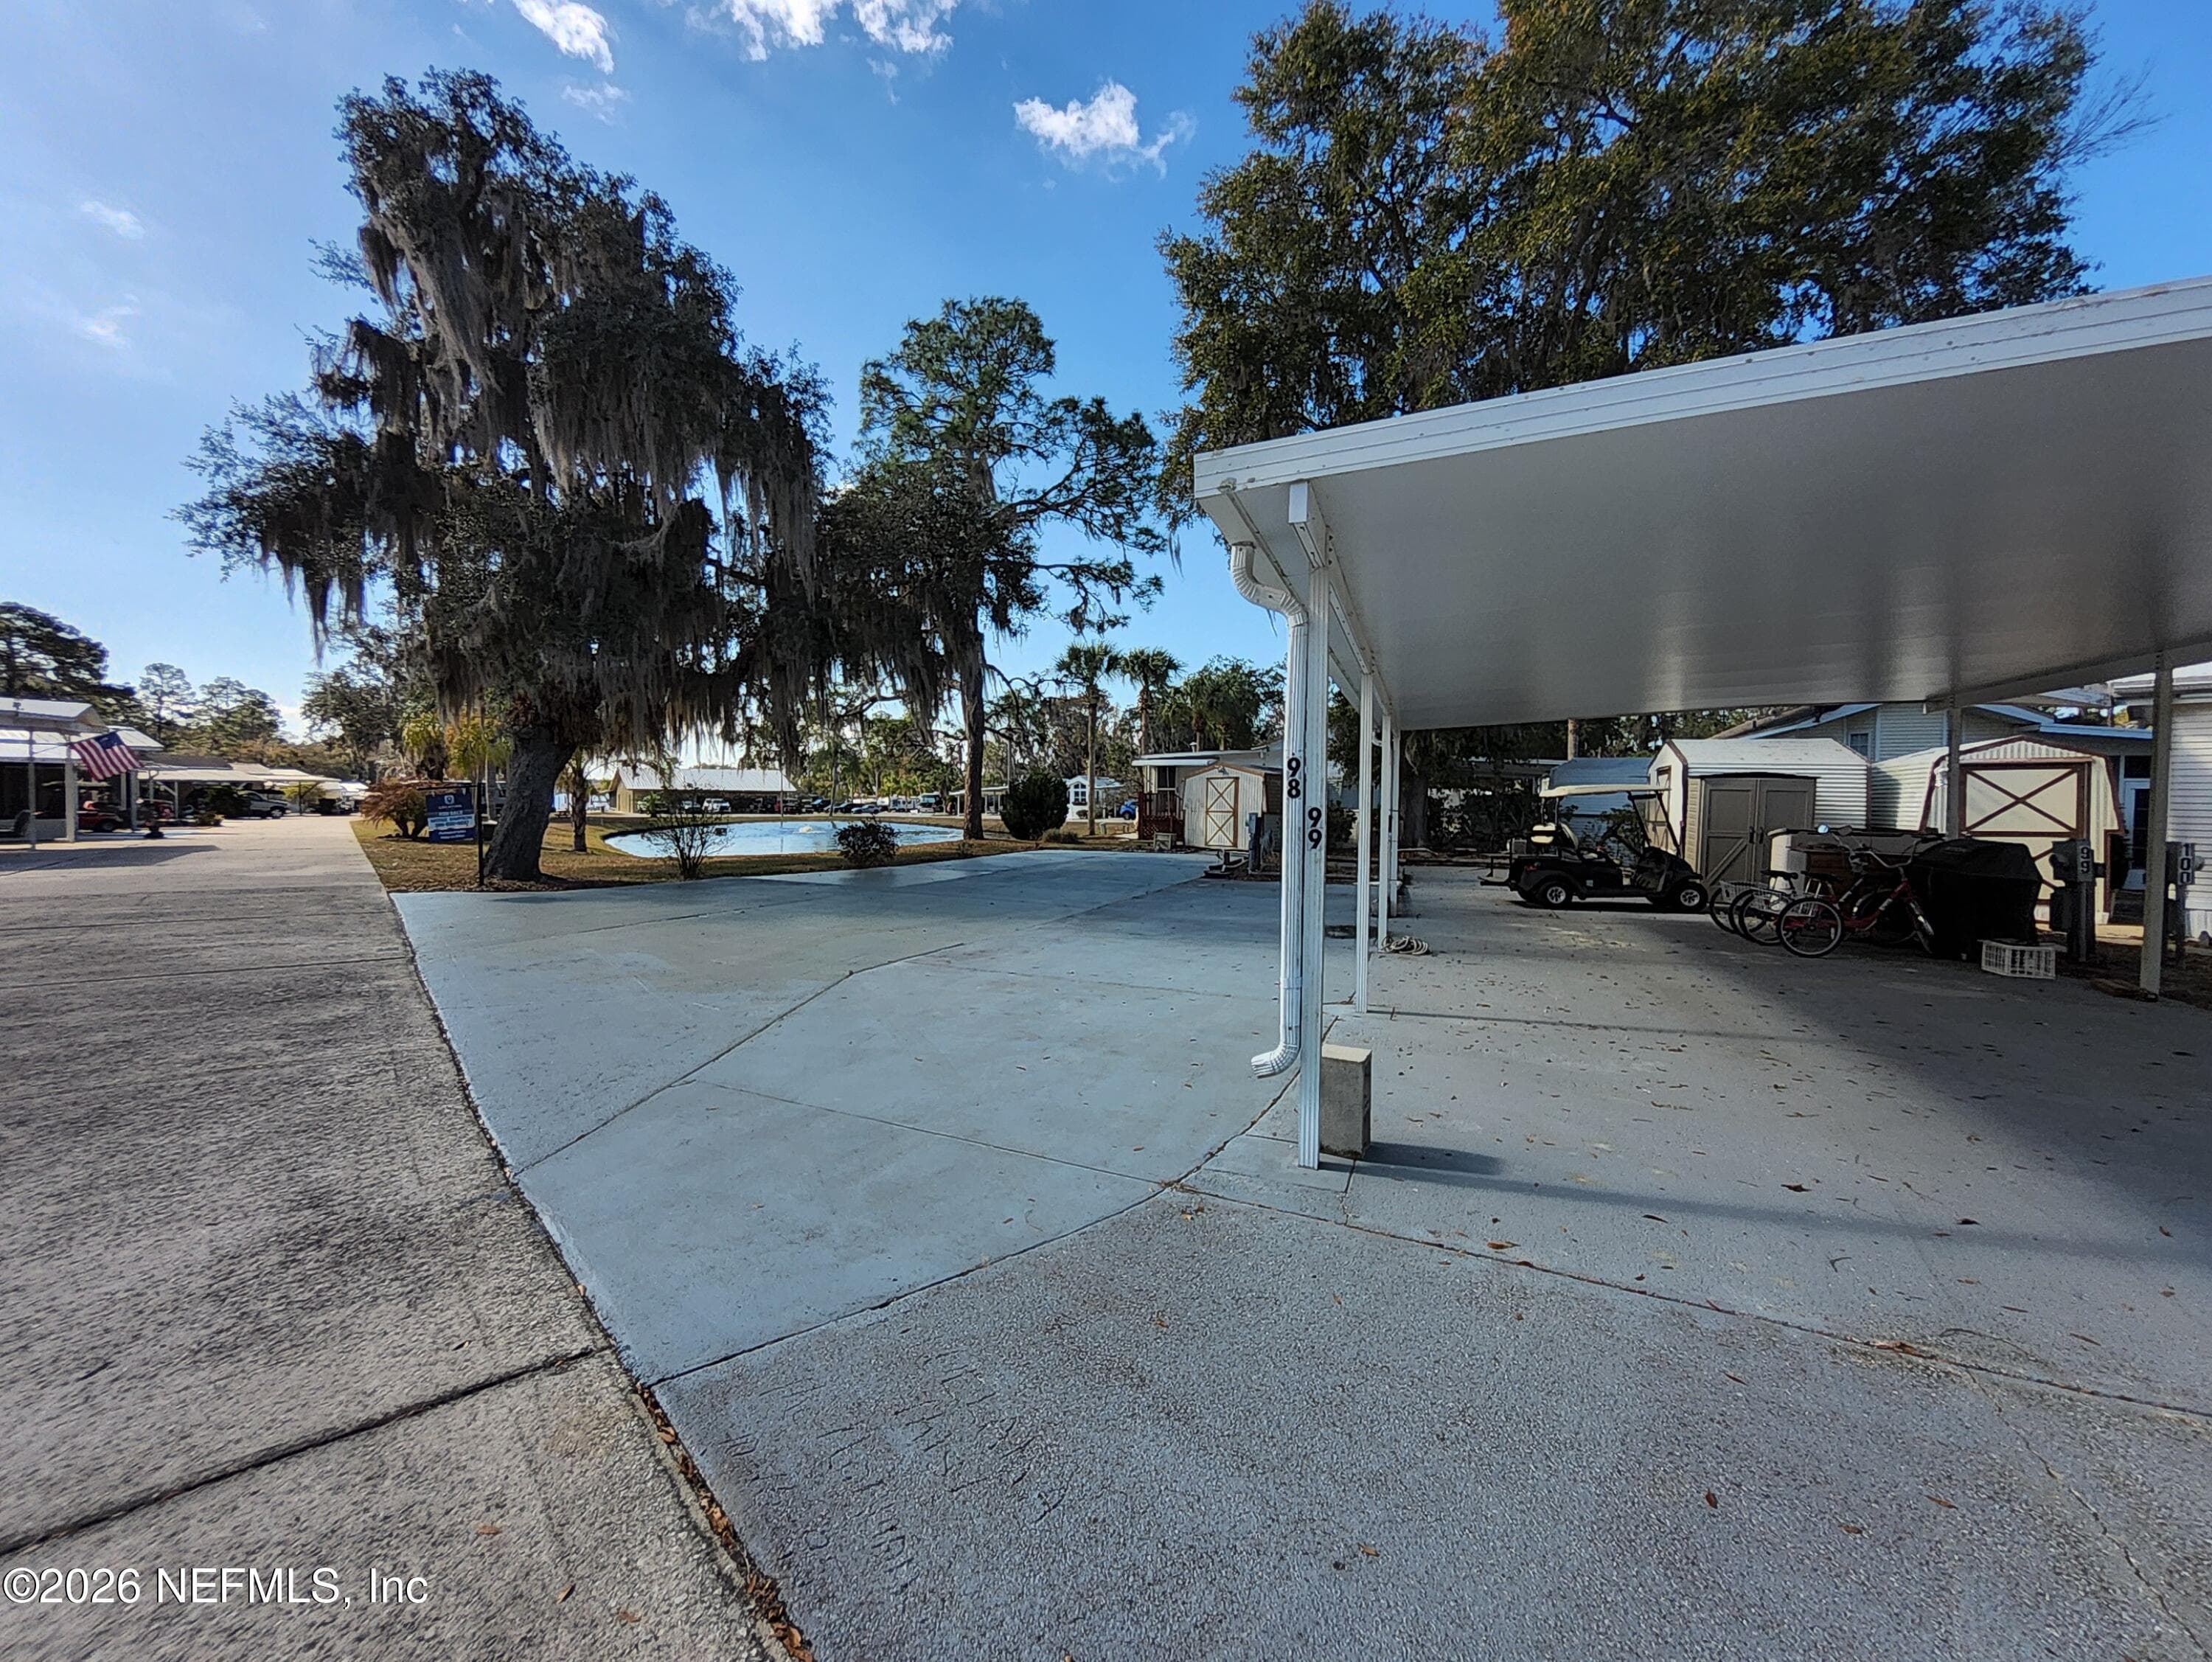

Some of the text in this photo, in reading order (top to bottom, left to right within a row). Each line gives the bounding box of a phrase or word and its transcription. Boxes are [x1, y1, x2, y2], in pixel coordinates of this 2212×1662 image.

[1287, 757, 1301, 799] 98
[1308, 807, 1322, 849] 99
[2081, 846, 2091, 875] 99
